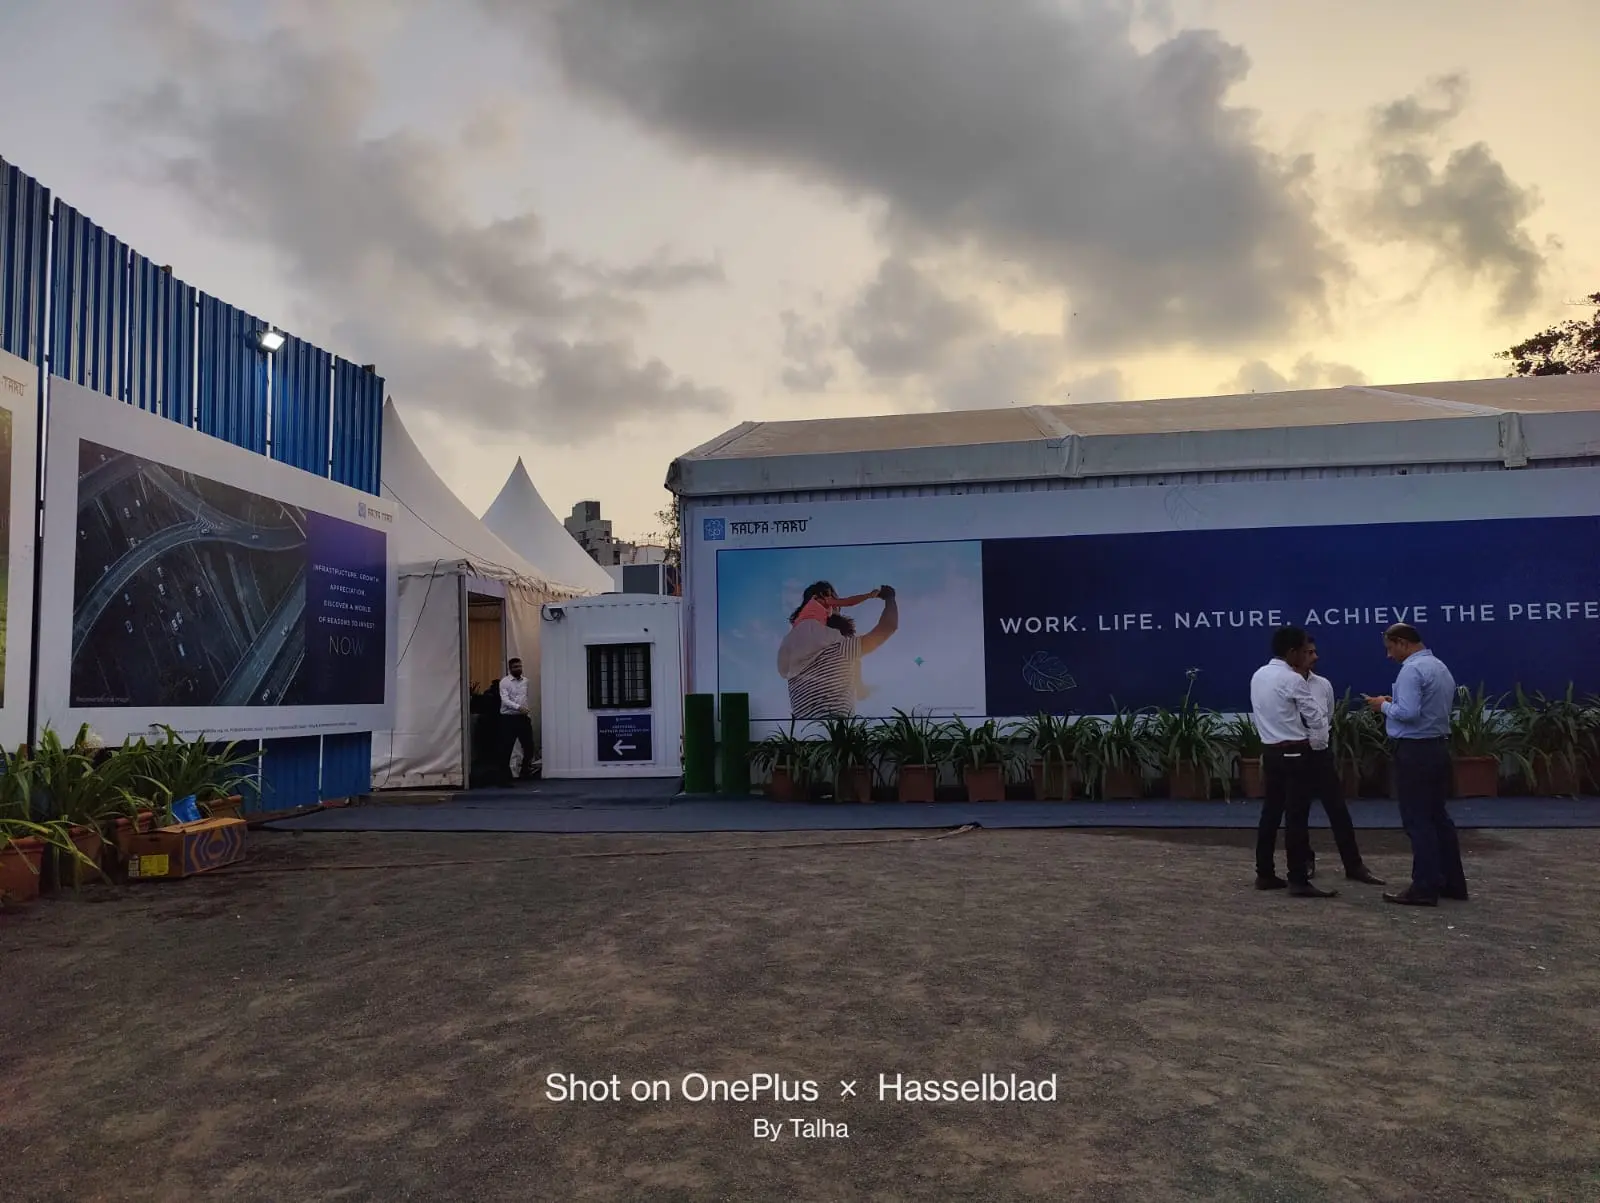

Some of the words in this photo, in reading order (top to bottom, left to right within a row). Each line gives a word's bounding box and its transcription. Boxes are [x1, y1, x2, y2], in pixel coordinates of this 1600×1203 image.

[999, 615, 1087, 634] WORK.
[1098, 613, 1162, 631] LIFE.
[1175, 609, 1292, 629] NATURE.
[1304, 605, 1428, 625] ACHIEVE
[1440, 604, 1496, 622] THE
[1508, 601, 1600, 621] PERFE
[329, 635, 364, 656] NOW
